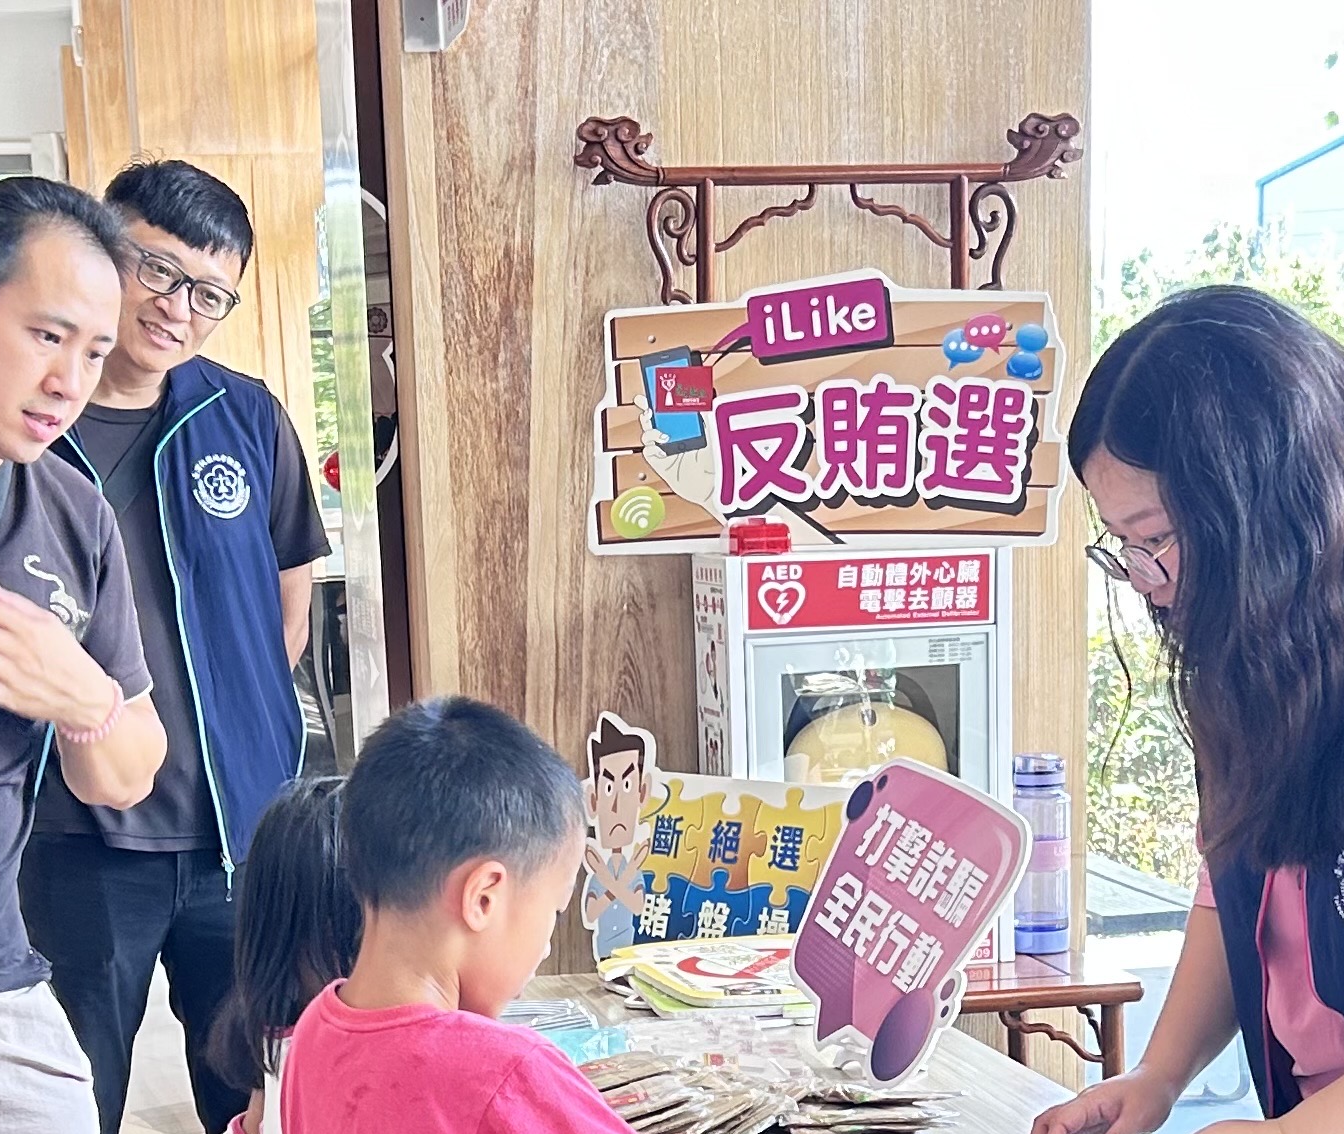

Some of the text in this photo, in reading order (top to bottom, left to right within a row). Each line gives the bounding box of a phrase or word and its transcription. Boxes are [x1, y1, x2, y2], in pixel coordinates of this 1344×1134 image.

[763, 295, 876, 345] iLike
[714, 382, 1026, 504] 反賄選
[761, 564, 803, 581] AED
[837, 559, 981, 589] 自動體外心臟
[859, 586, 978, 613] 電擊去顫器
[651, 813, 805, 873] 斷絕選
[855, 803, 989, 929] 打擊詐騙
[814, 871, 944, 995] 全民行動
